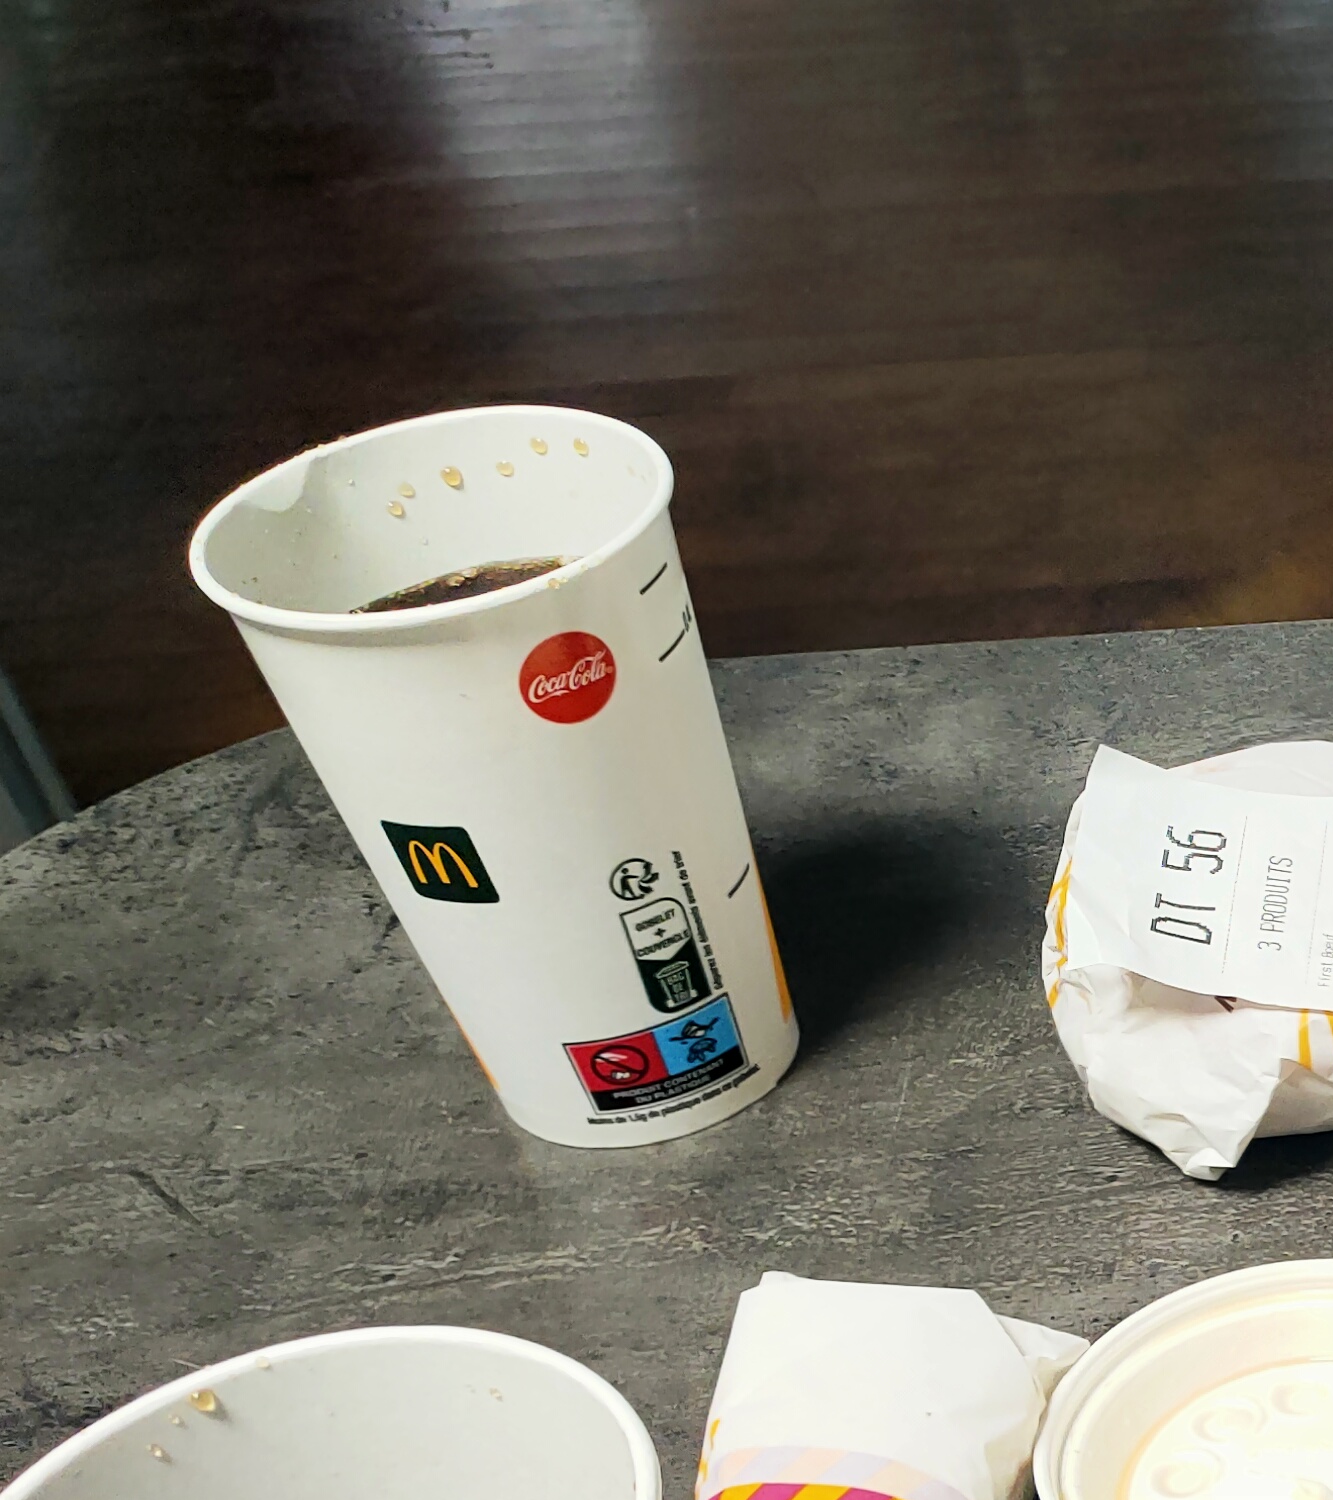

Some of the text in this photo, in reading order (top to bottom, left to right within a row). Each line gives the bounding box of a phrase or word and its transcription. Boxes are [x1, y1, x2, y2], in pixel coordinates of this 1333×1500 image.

[1150, 825, 1227, 945] DT 56
[1257, 855, 1293, 951] 3 PRODUITS
